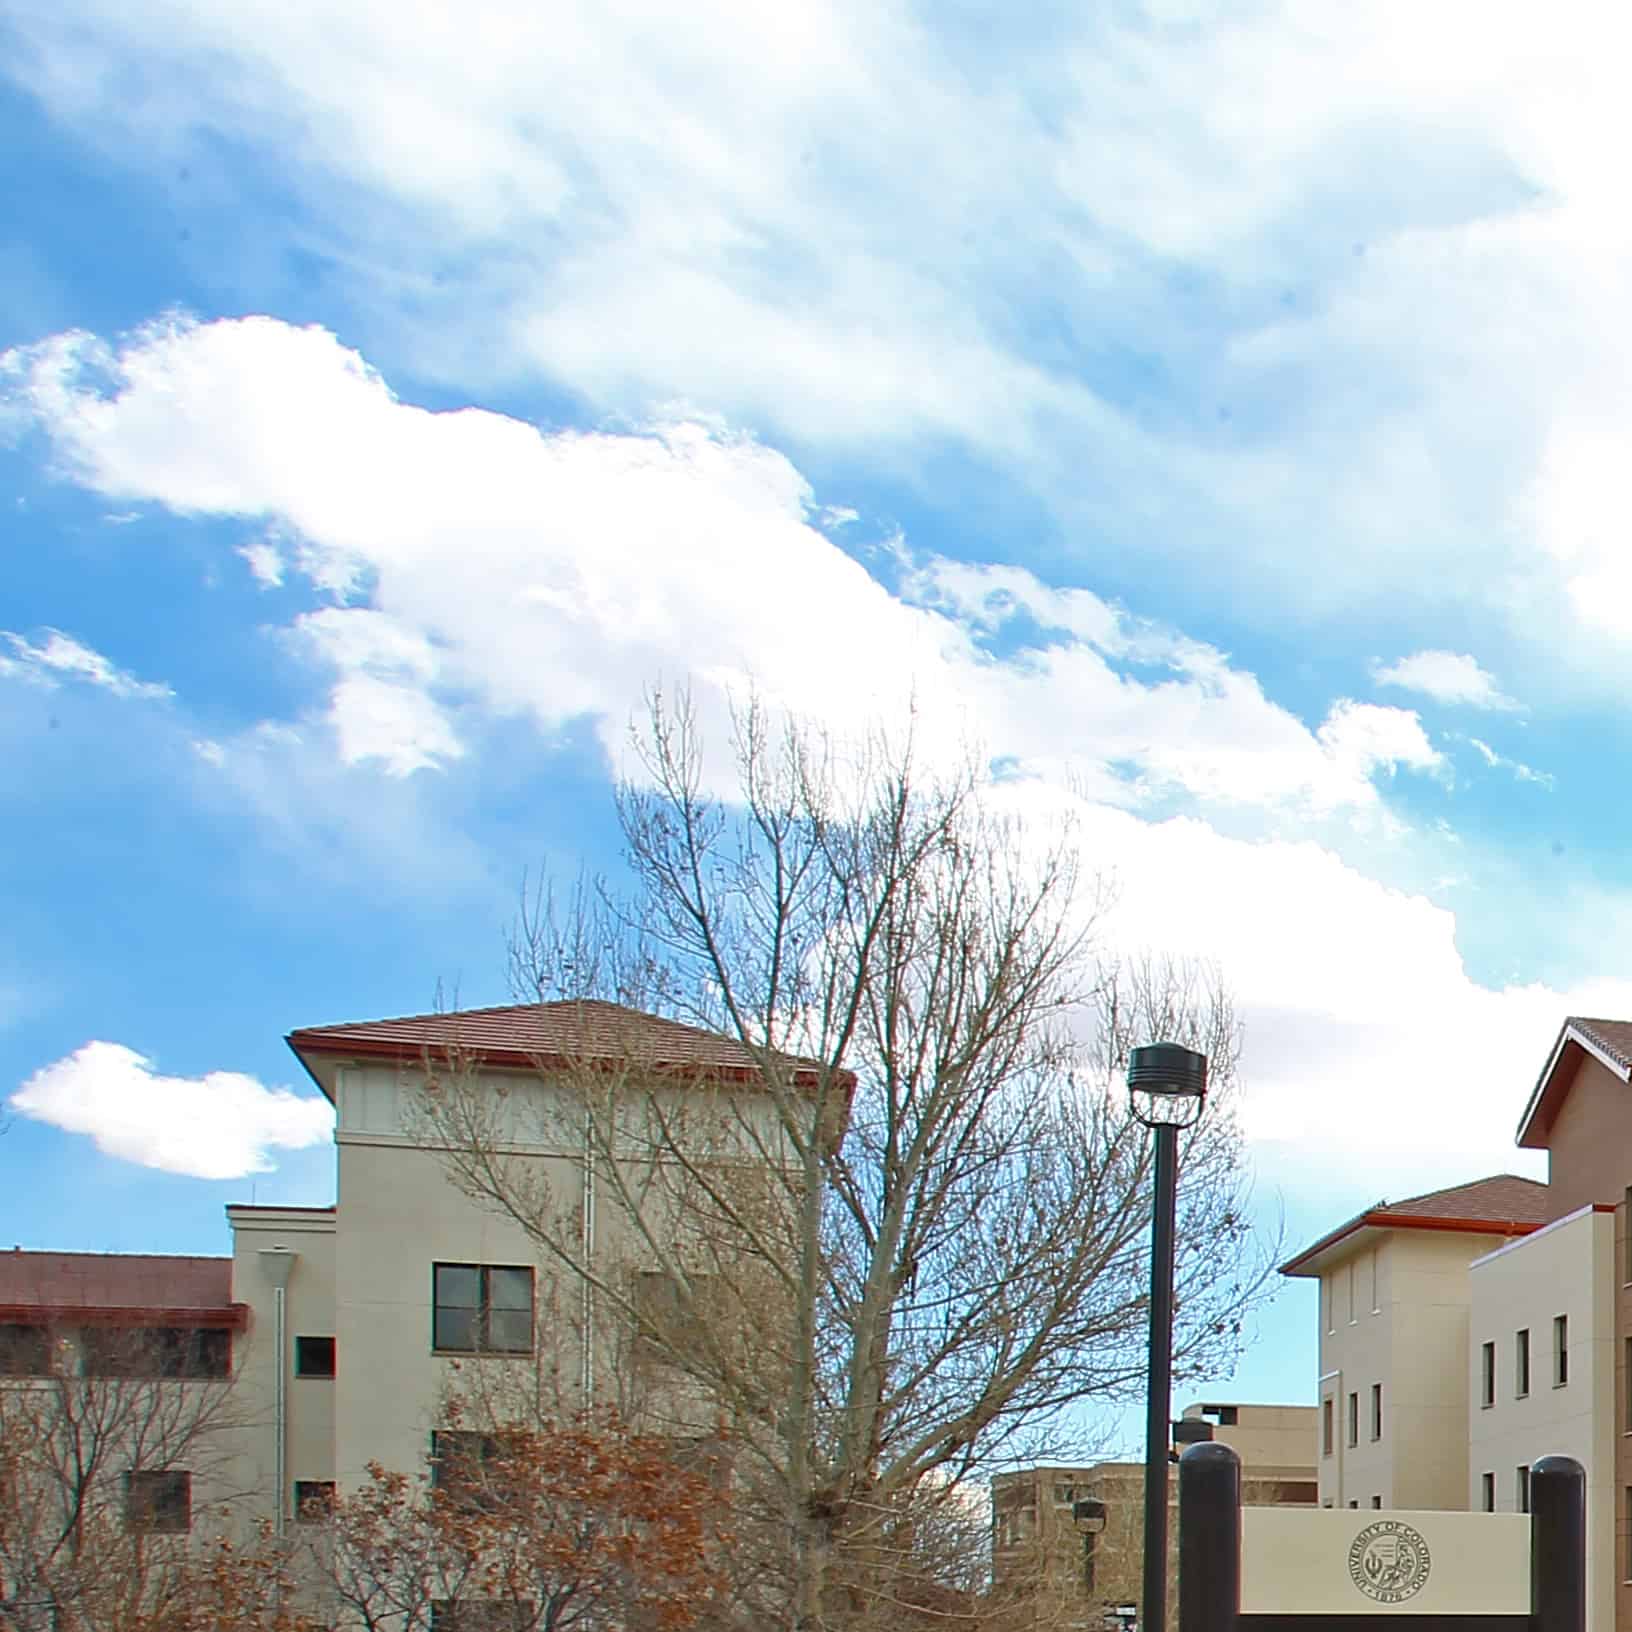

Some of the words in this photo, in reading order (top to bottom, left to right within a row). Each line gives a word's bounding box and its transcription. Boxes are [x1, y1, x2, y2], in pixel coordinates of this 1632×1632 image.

[1350, 1524, 1380, 1590] UNIVERSITY
[1385, 1521, 1399, 1533] OF
[1403, 1527, 1430, 1590] COLORADO
